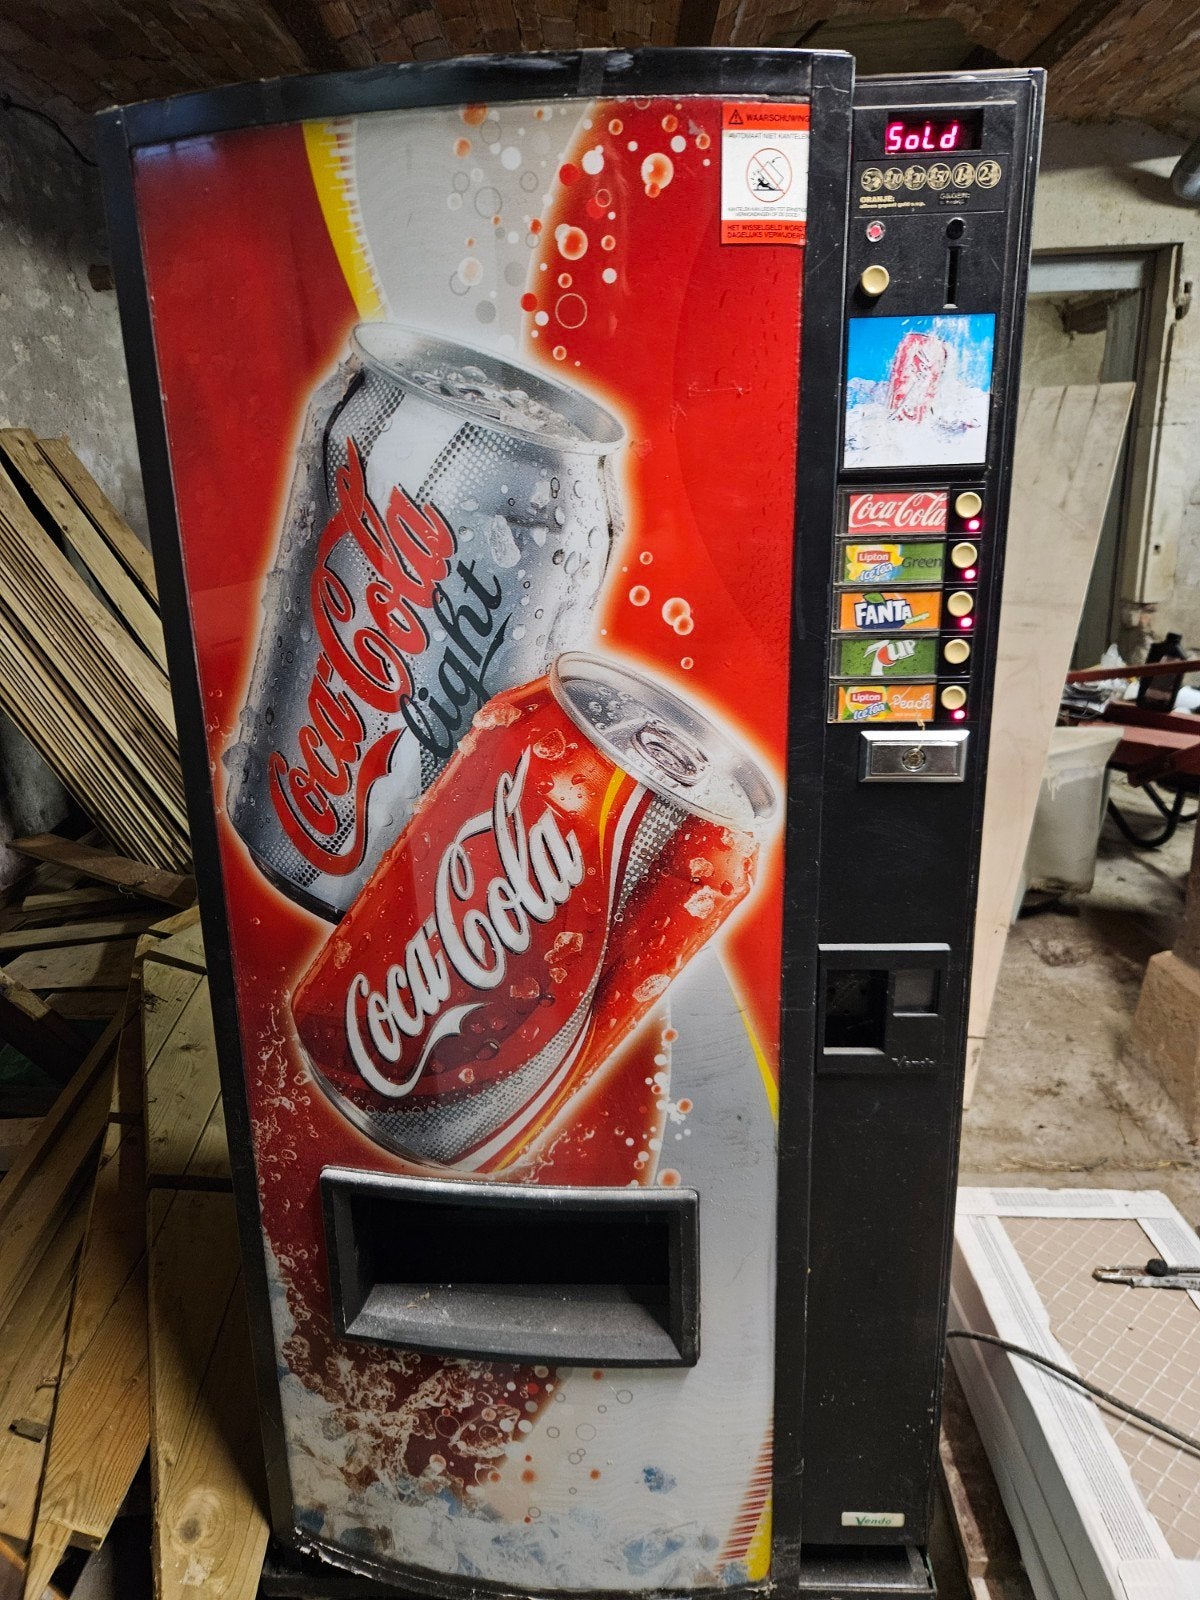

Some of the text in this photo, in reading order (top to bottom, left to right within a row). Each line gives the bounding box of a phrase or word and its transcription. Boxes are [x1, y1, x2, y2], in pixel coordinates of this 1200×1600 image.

[859, 552, 889, 562] Lipton
[902, 555, 943, 569] Green
[855, 599, 912, 626] FANTA
[399, 558, 512, 759] light
[852, 693, 881, 703] Lipton
[892, 693, 933, 709] Peach
[856, 1516, 892, 1526] Vendo
